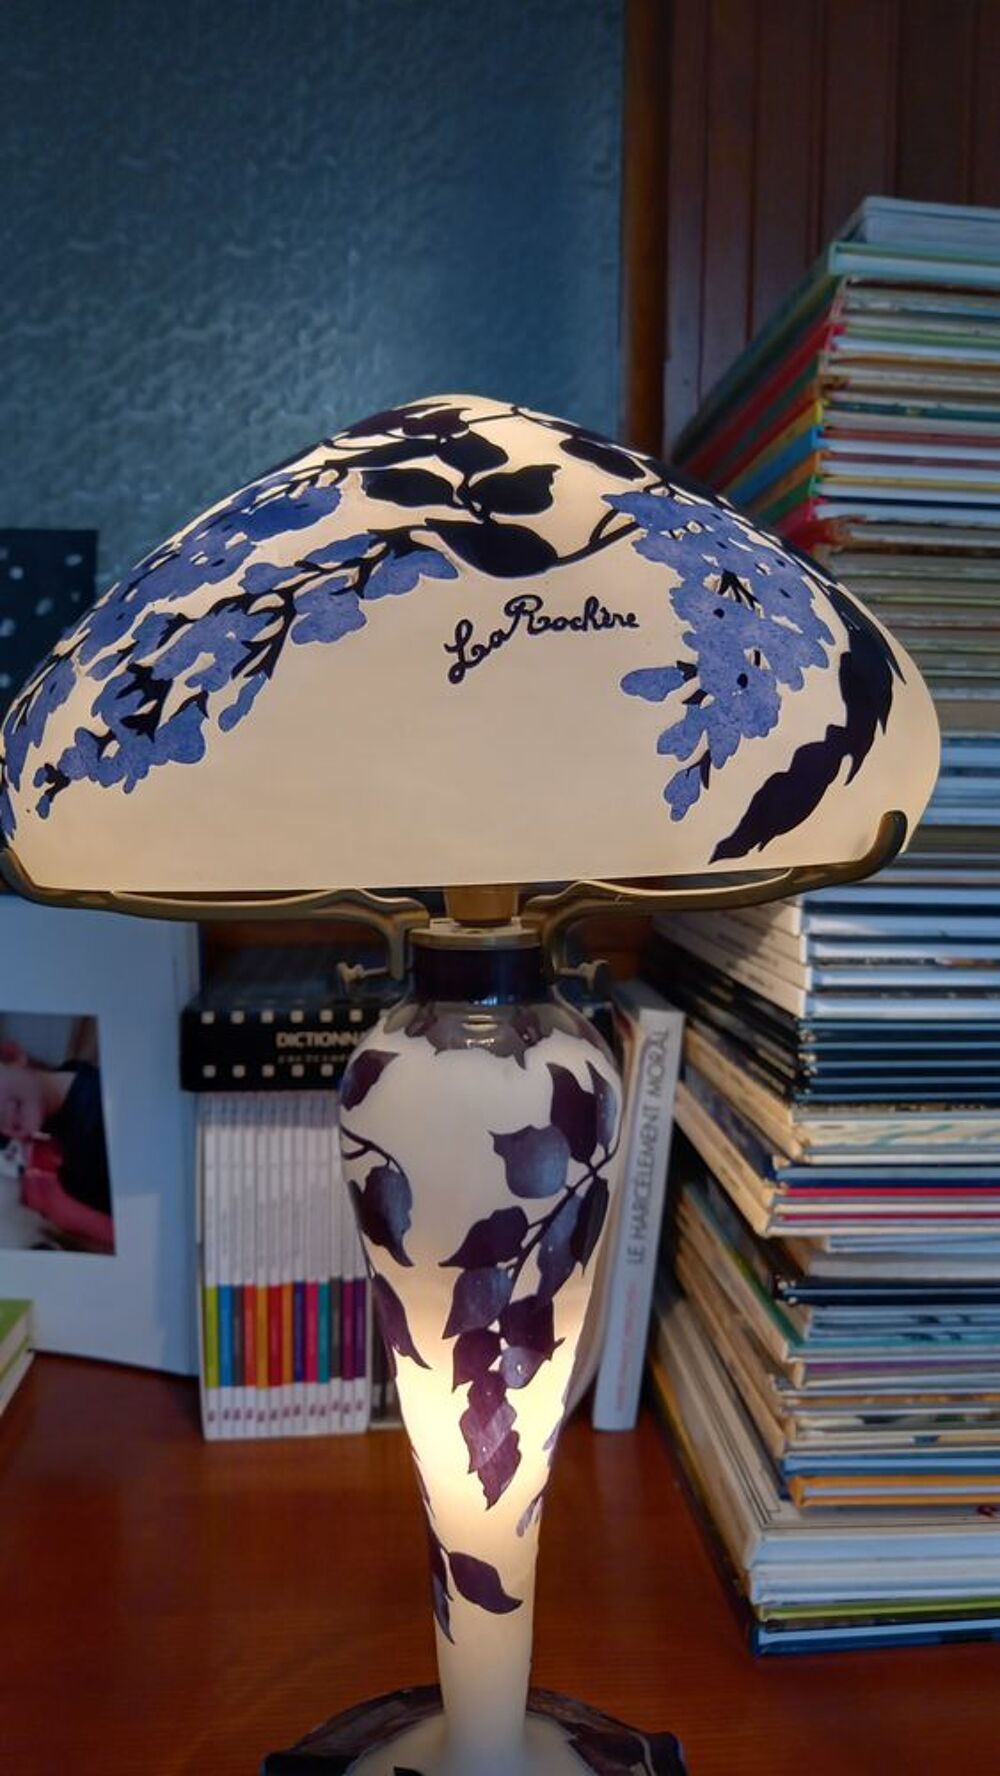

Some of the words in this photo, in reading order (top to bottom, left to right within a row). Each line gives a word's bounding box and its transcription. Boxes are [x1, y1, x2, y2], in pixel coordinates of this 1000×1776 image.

[443, 619, 508, 685] La
[503, 593, 641, 636] Rochère
[275, 1031, 363, 1048] DICTIONN
[625, 1245, 647, 1266] LE
[645, 1027, 670, 1098] MORAL
